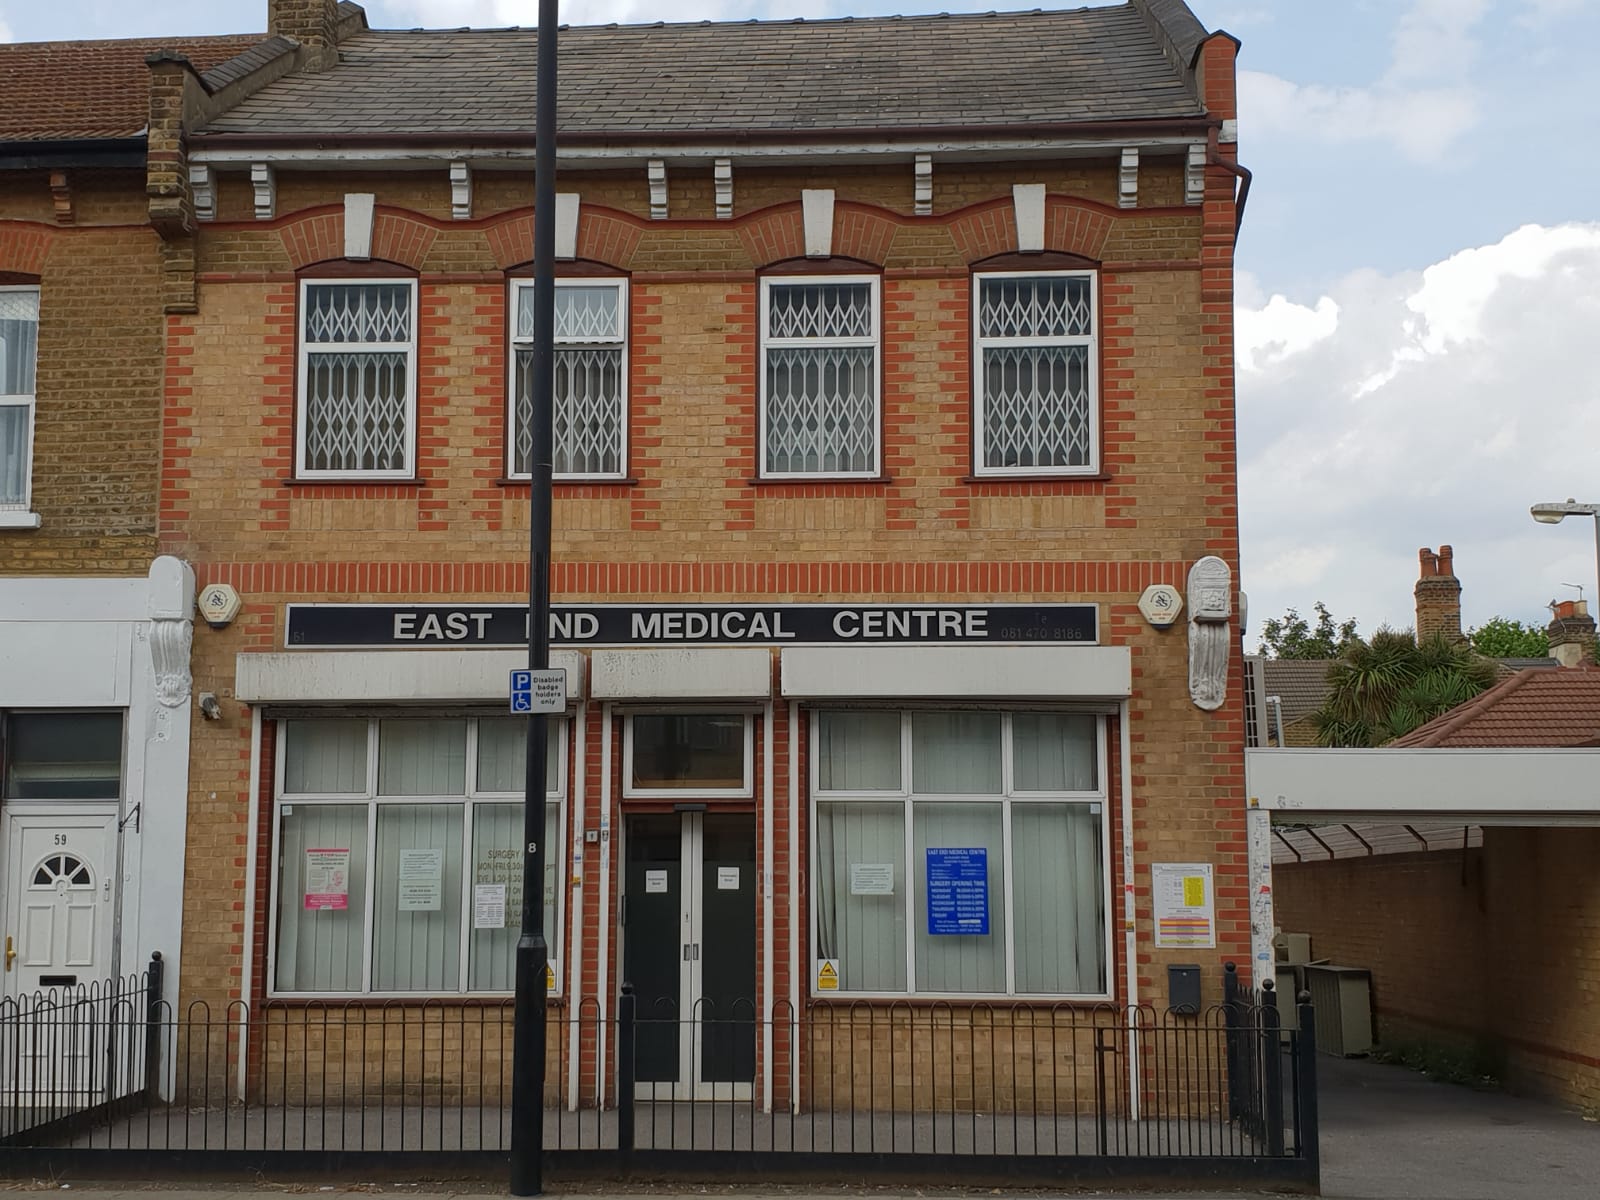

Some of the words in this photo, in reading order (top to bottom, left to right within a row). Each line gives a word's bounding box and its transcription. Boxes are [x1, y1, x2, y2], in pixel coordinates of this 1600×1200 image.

[393, 612, 493, 640] EAST
[525, 612, 600, 639] ND
[630, 611, 796, 640] MEDICAL
[832, 609, 989, 639] CENTRE
[1001, 627, 1022, 639] 081
[1054, 627, 1082, 639] 8186
[517, 674, 529, 689] P
[54, 834, 67, 846] 59
[528, 842, 537, 853] 8
[488, 849, 520, 859] SURGERY
